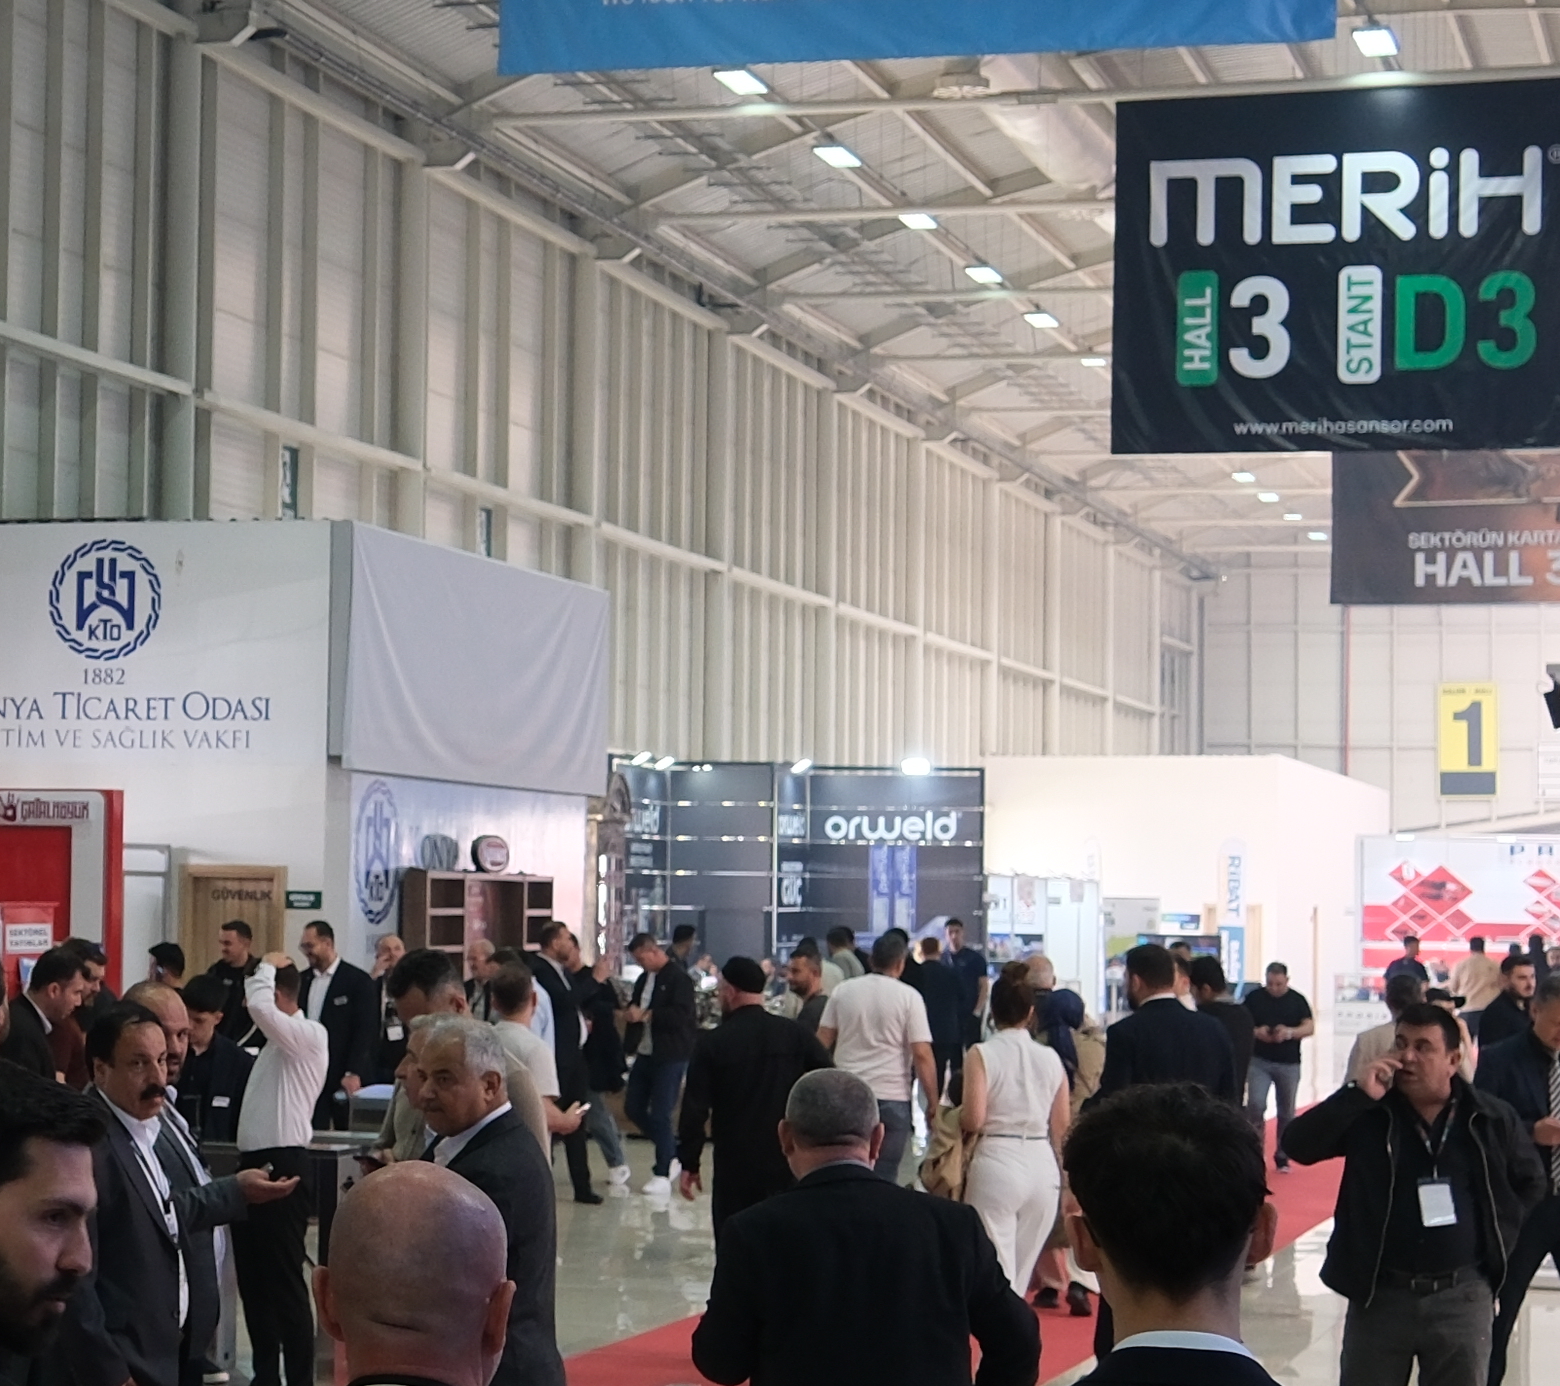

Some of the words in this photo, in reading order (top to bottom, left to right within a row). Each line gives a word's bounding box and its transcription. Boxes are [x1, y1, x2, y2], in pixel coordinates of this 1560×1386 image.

[1184, 286, 1214, 371] HALL
[1227, 274, 1292, 380] 3
[1345, 272, 1376, 378] STANT
[1394, 269, 1539, 374] D3
[1413, 551, 1534, 588] HALL
[87, 618, 121, 641] KTO
[82, 668, 126, 686] 1882
[52, 690, 176, 721] TİCARET
[182, 690, 271, 722] ODASI
[55, 729, 82, 749] VE
[91, 726, 175, 750] SAĞLIK
[183, 729, 251, 750] VAKFI
[1453, 700, 1482, 767] 1
[824, 810, 957, 842] orweld
